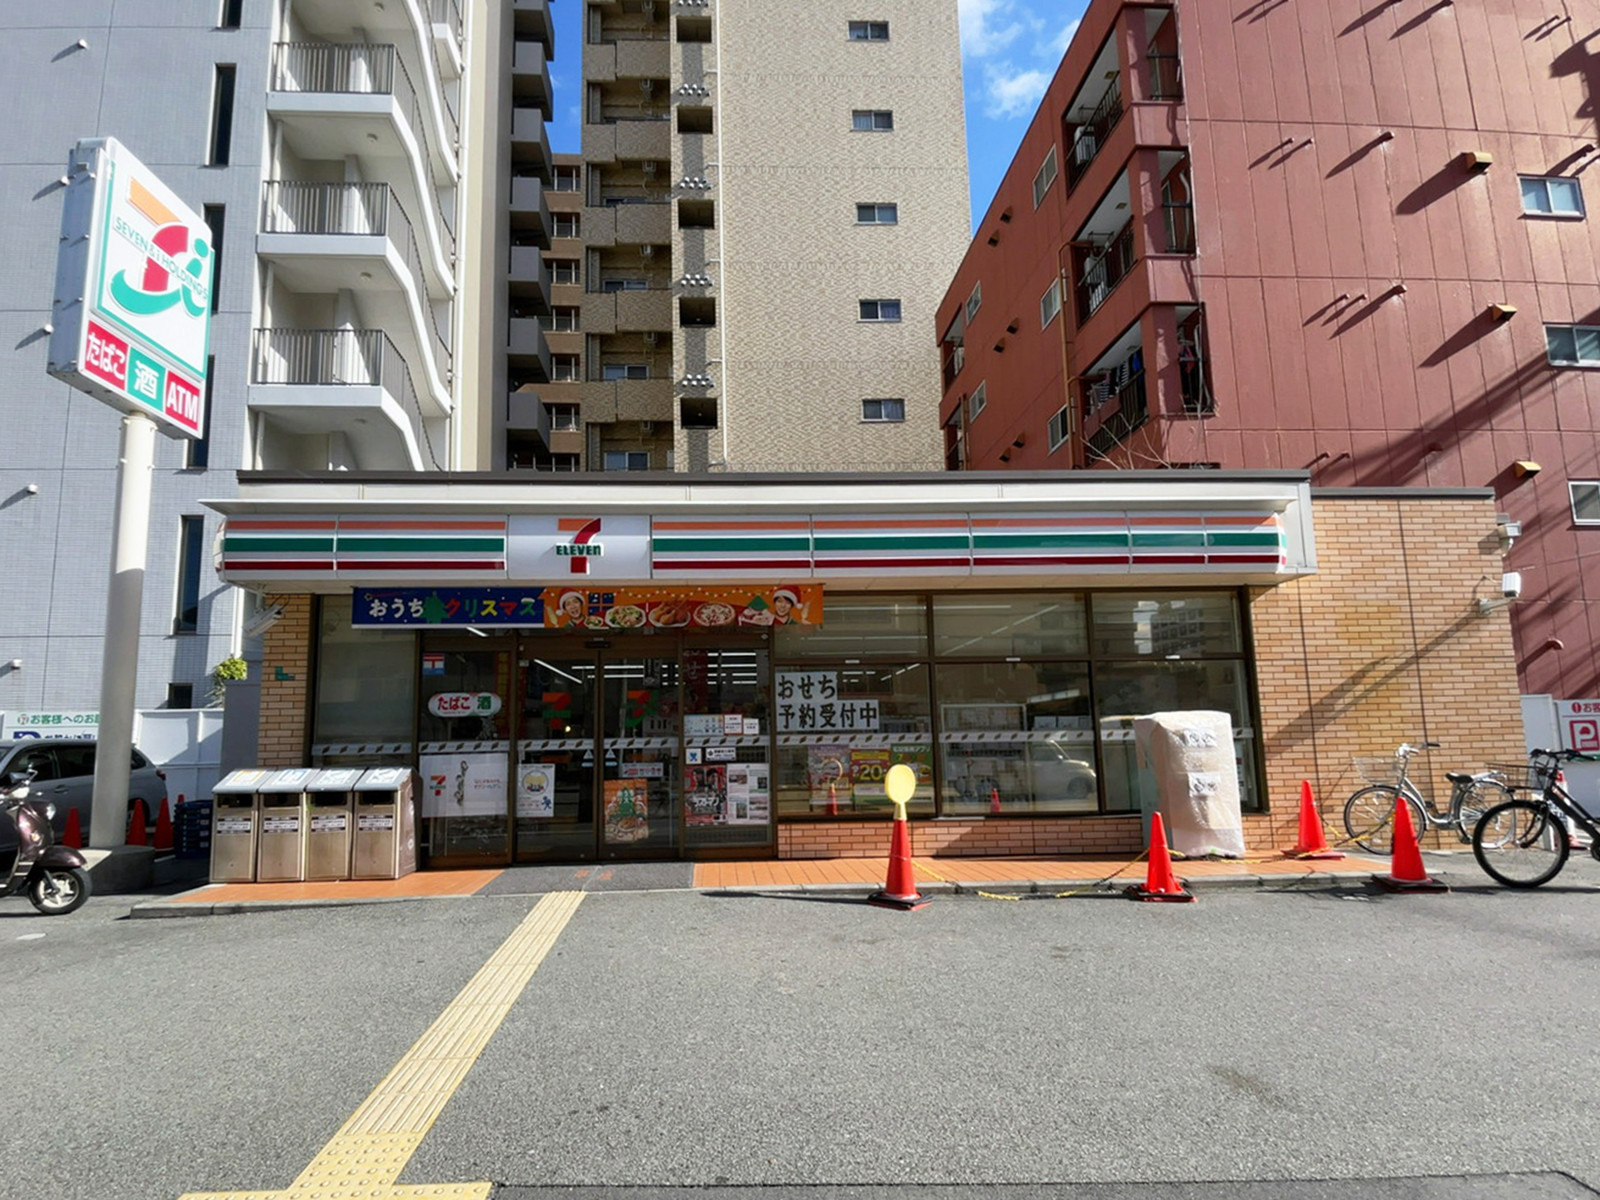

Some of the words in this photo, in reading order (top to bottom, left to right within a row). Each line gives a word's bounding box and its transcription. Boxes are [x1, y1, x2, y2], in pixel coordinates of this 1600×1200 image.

[115, 216, 148, 252] SEVEN
[161, 255, 208, 300] HOLDINGS
[86, 331, 126, 381] たばこ
[134, 360, 159, 400] 酒
[166, 381, 199, 423] ATM
[369, 598, 424, 618] おうち
[445, 597, 535, 618] クリスマス
[778, 674, 836, 700] おせち
[437, 696, 470, 711] たばこ
[477, 695, 491, 710] 酒
[778, 702, 877, 729] 予約受付中
